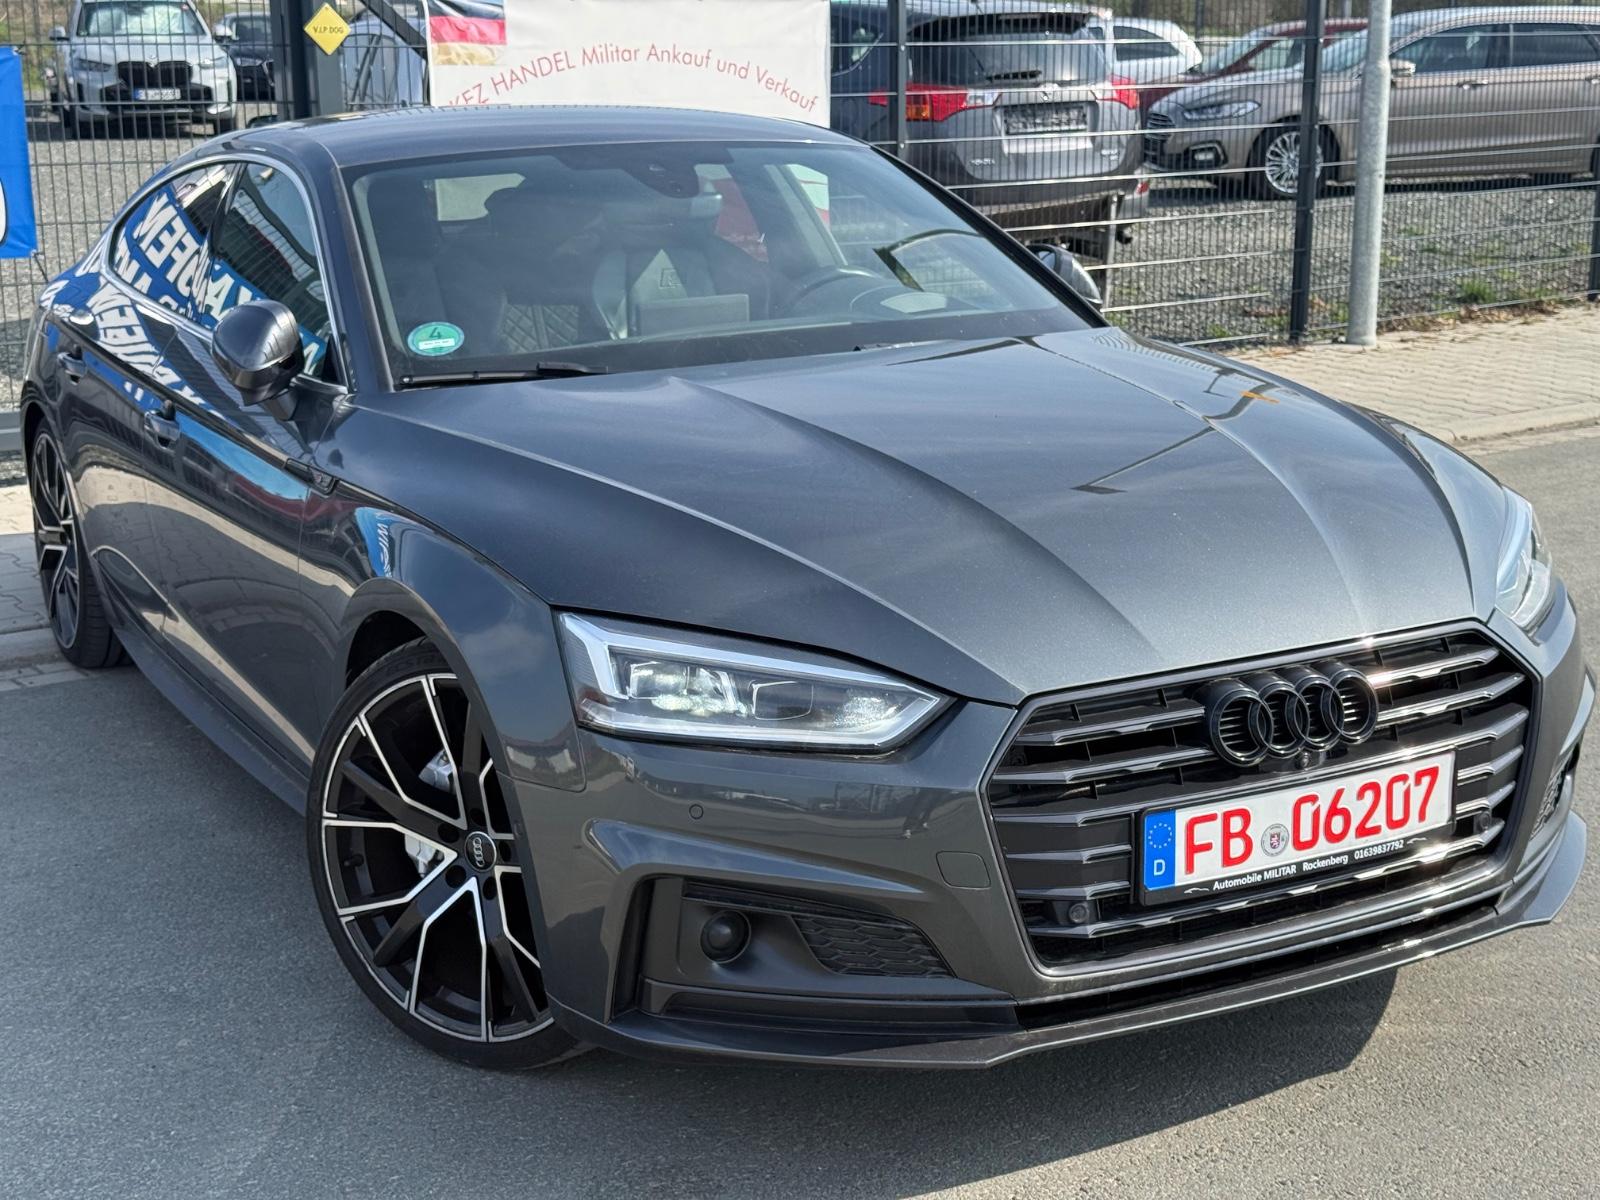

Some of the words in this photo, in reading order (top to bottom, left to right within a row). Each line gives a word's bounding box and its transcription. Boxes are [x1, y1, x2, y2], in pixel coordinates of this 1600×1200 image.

[329, 26, 344, 34] DOG
[490, 51, 576, 96] HANDEL
[581, 43, 640, 67] Militar
[646, 43, 712, 69] Ankauf
[716, 61, 751, 80] und
[756, 65, 819, 113] Verkauf
[428, 326, 442, 339] 4
[1184, 808, 1254, 875] FB
[1292, 765, 1440, 851] 06207
[1153, 859, 1166, 876] D
[1212, 873, 1263, 891] Automobile
[1263, 864, 1297, 880] MILITAR
[1302, 854, 1349, 872] Rockenberg
[1353, 840, 1404, 859] 01639837792
